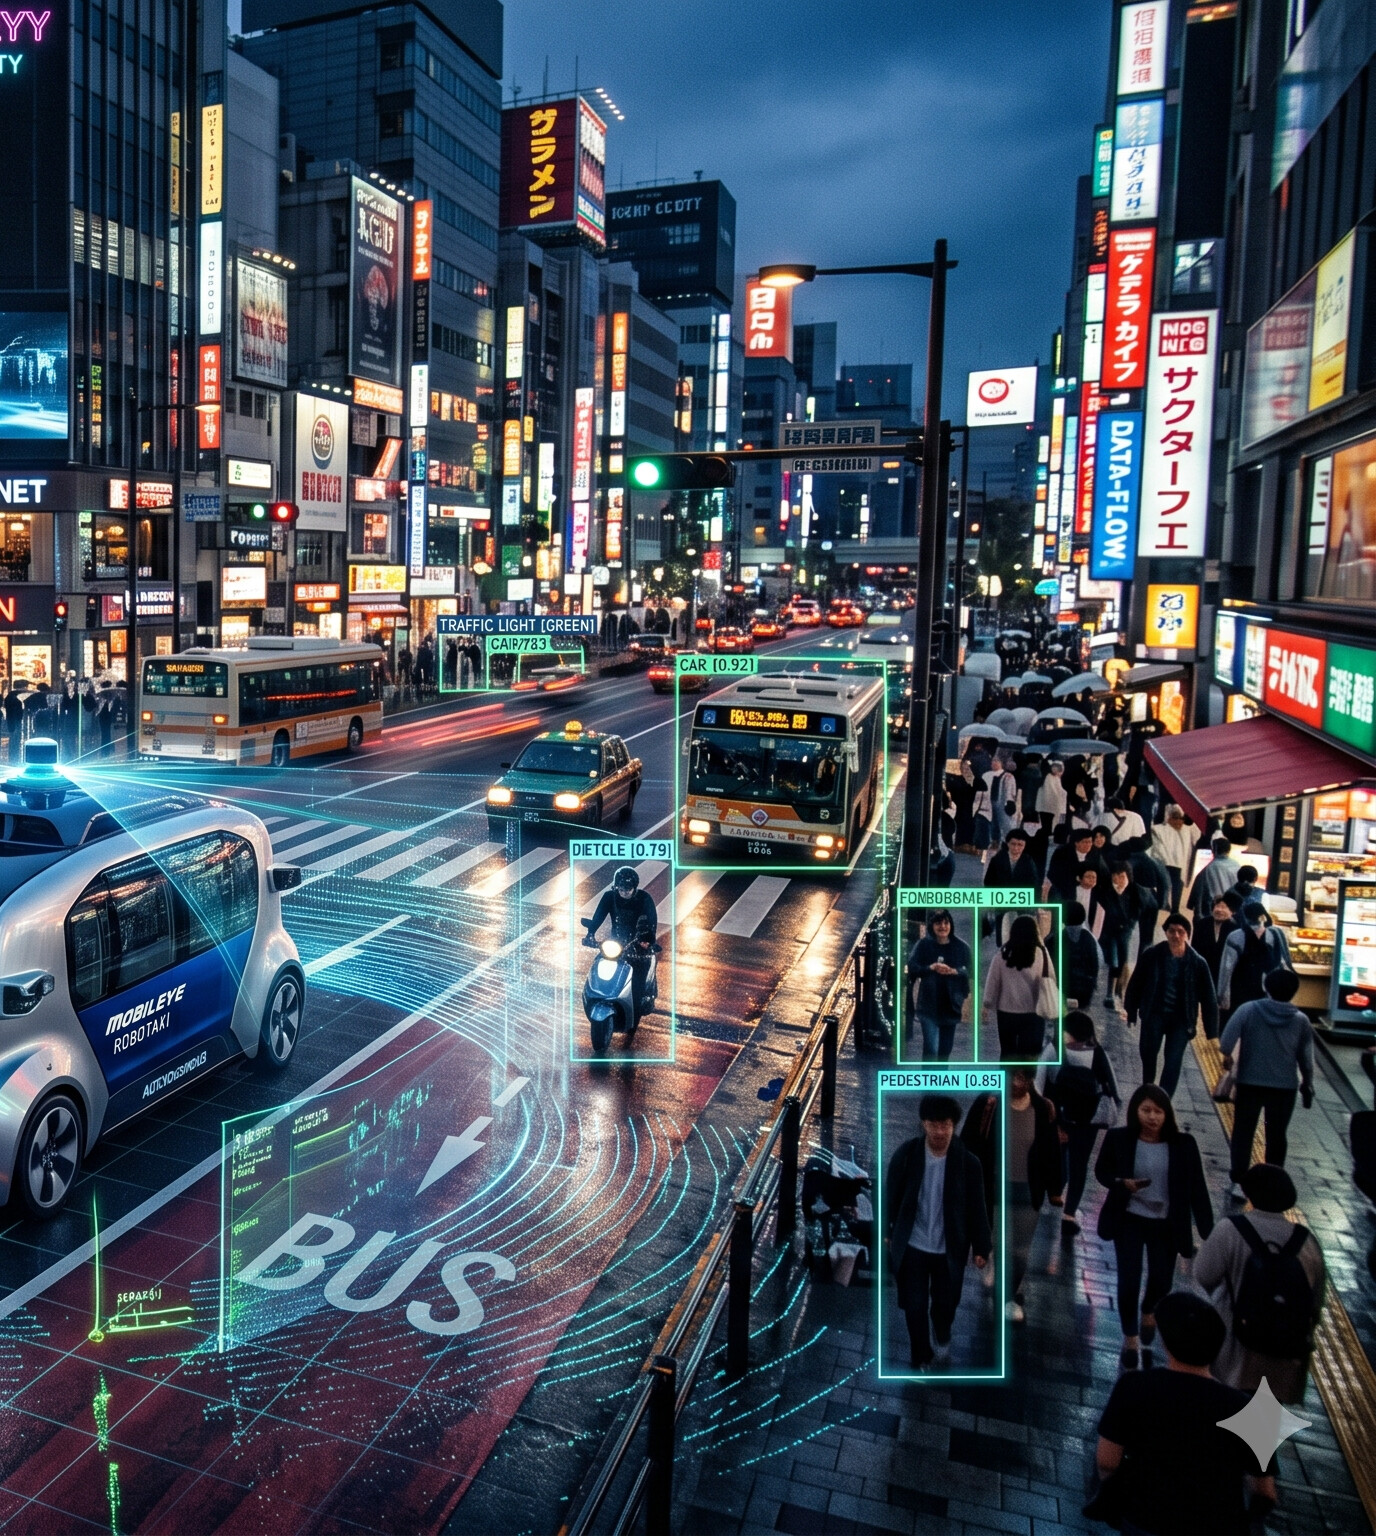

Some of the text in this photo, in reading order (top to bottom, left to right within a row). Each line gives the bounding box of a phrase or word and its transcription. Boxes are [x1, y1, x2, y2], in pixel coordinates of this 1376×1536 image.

[1103, 420, 1135, 559] DATA-FLOW
[105, 983, 186, 1036] MOBILEYE
[232, 1212, 517, 1336] BUS
